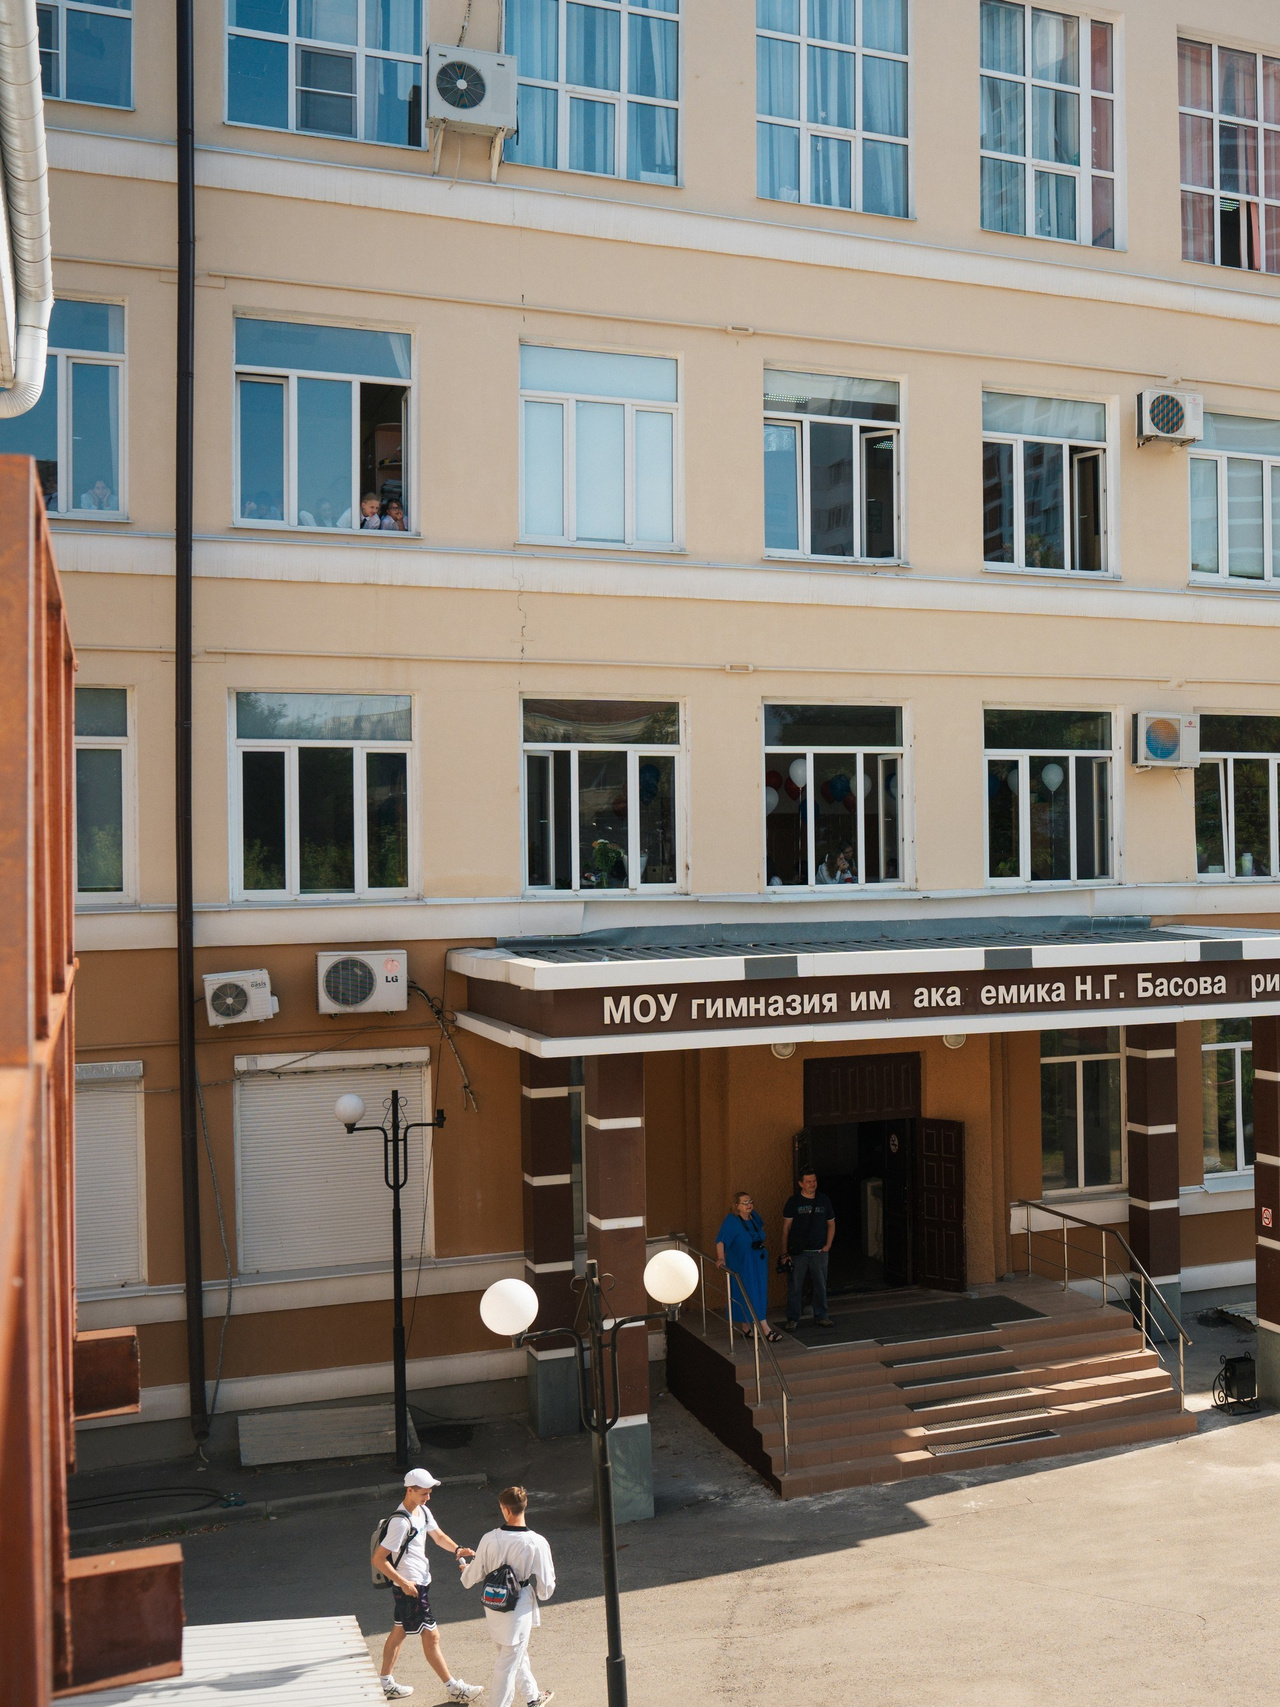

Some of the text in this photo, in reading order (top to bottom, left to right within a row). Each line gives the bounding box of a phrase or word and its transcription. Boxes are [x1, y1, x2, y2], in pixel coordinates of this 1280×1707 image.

[385, 975, 399, 983] LG
[604, 993, 678, 1025] МОУ
[691, 992, 838, 1020] гимназия
[850, 989, 891, 1012] им
[1075, 974, 1125, 1001] Н.Г.
[1137, 972, 1227, 998] Басова
